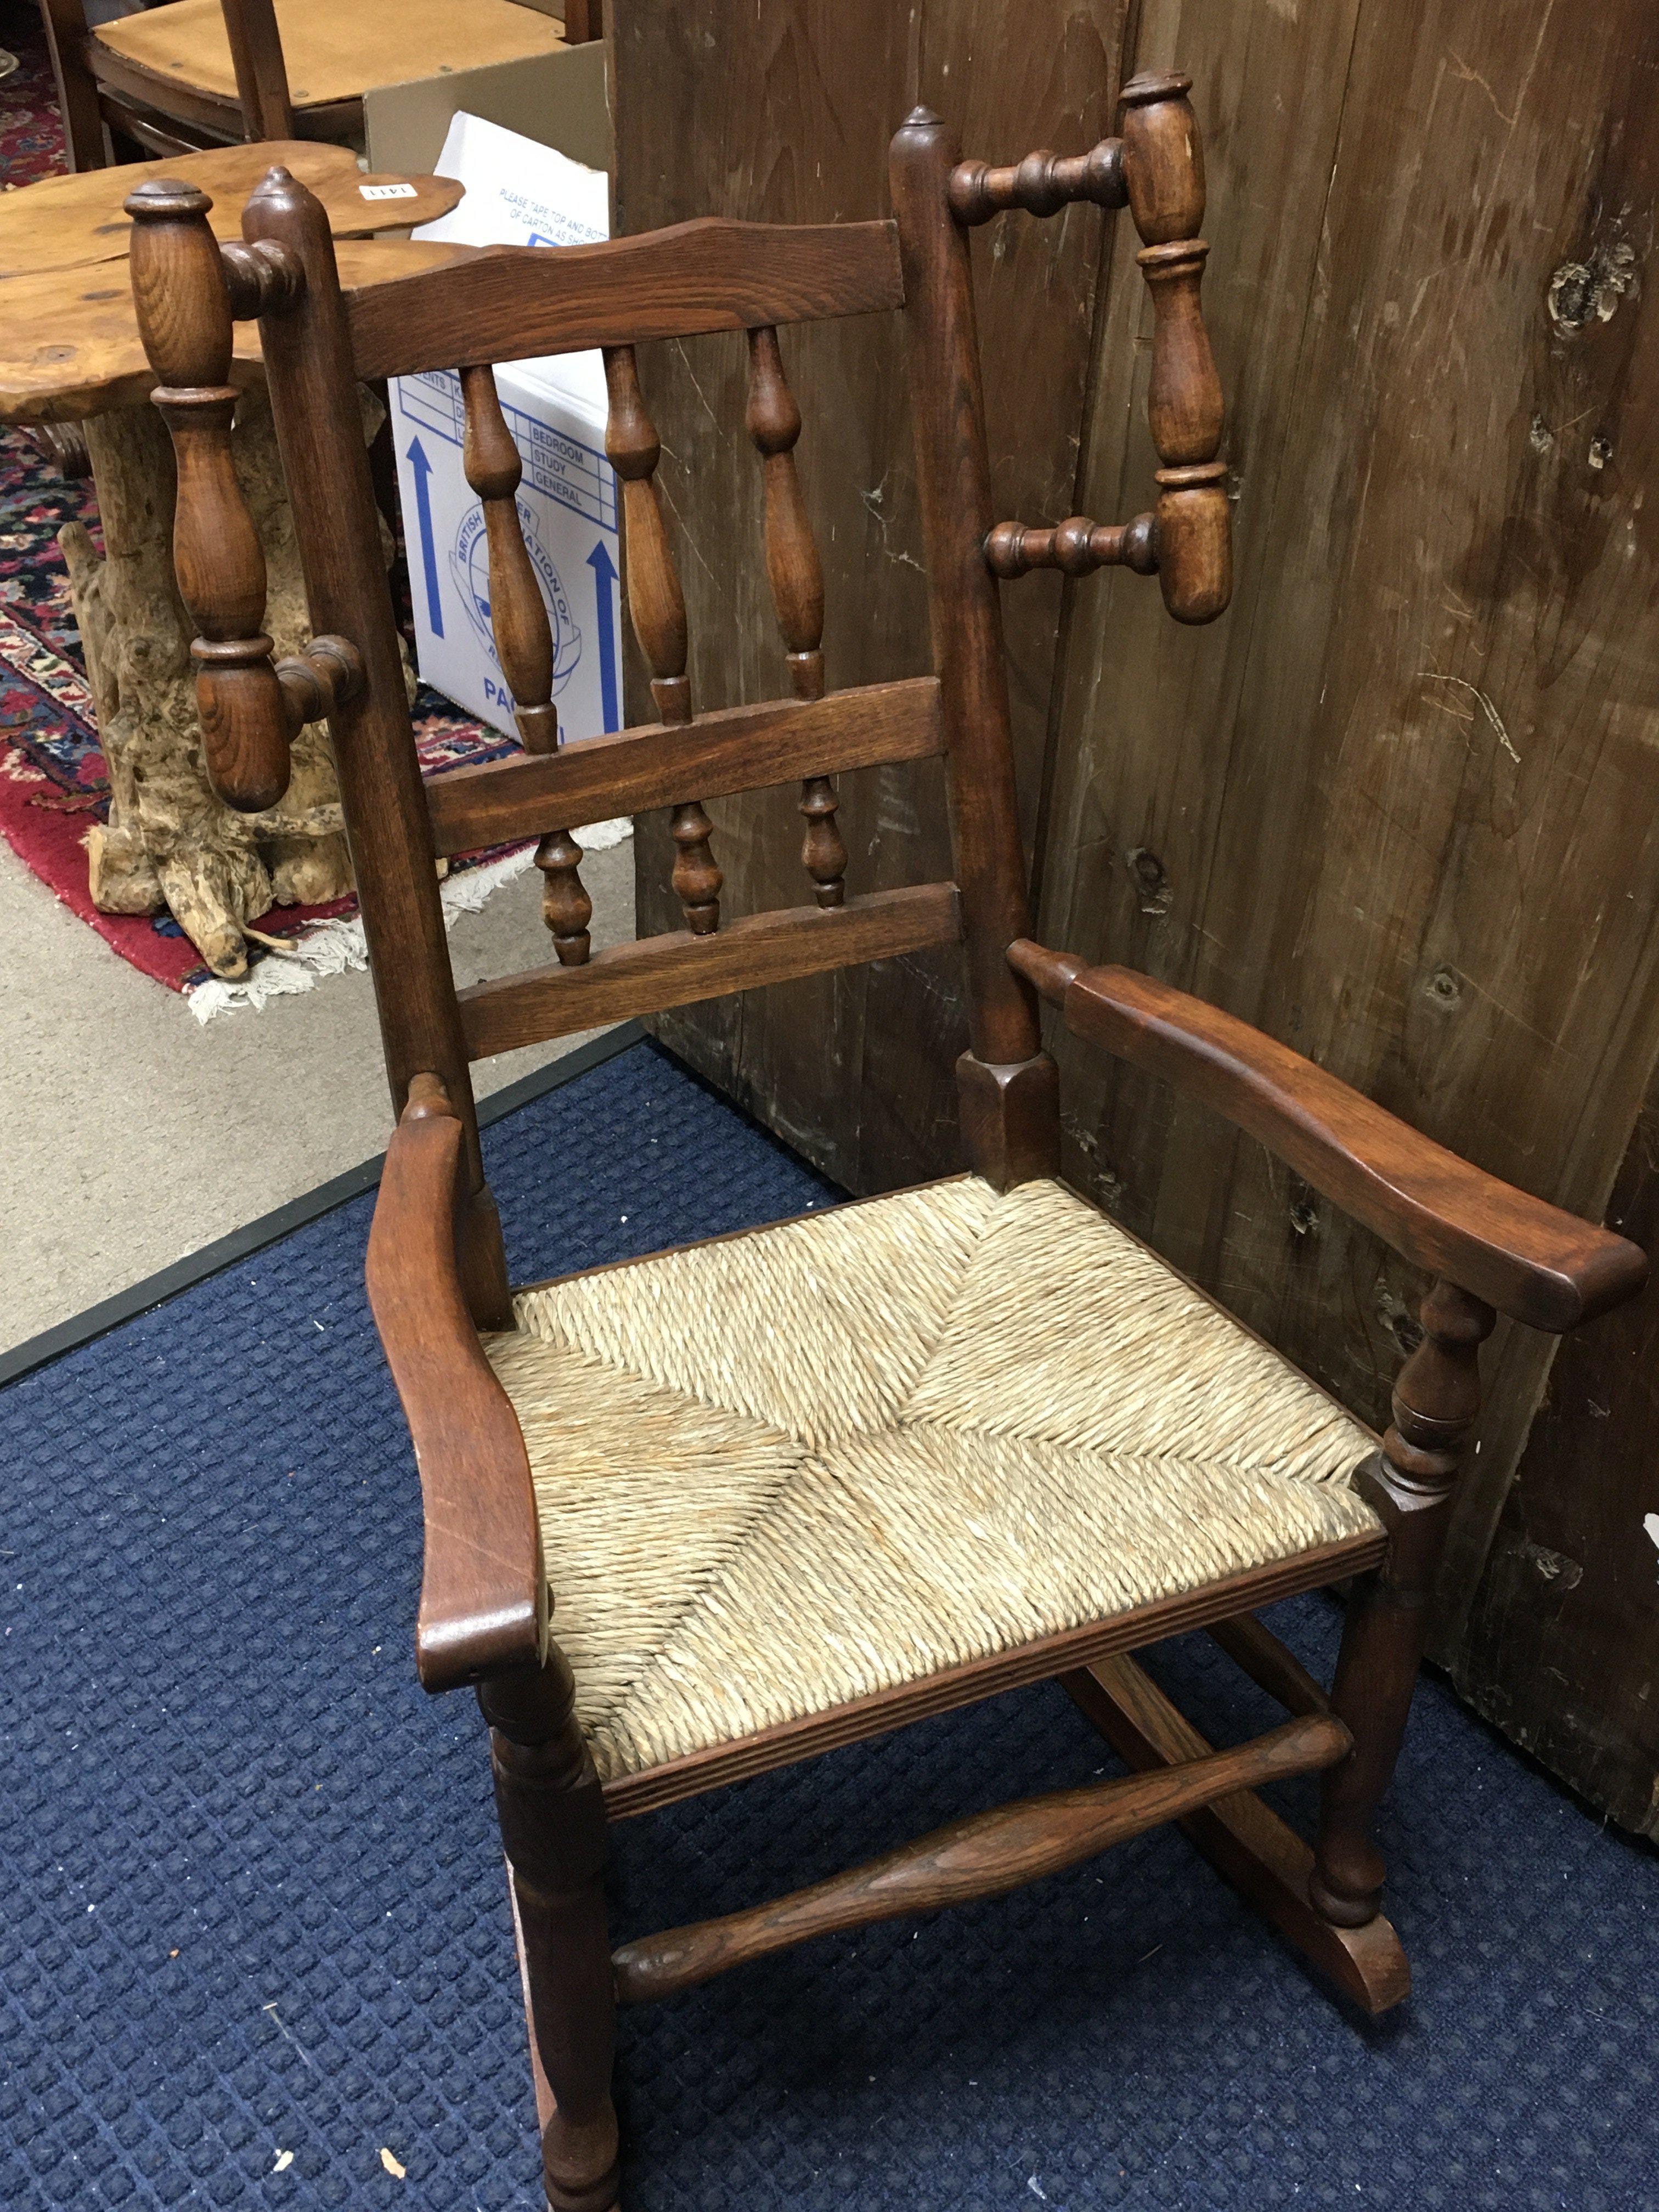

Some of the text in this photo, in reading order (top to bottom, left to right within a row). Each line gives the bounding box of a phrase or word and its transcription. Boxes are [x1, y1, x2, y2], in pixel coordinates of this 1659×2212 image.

[500, 188, 528, 208] PLEASE
[531, 201, 549, 218] TAPE
[551, 211, 566, 224] TOP
[567, 220, 584, 234] AND
[510, 208, 522, 218] OF
[522, 214, 554, 235] CARTON
[555, 230, 567, 241] AS
[533, 427, 583, 465] BEDROOM
[534, 449, 566, 475] STUDY
[535, 471, 582, 506] GENERAL
[458, 511, 482, 563] BRITISH
[557, 599, 569, 626] OF
